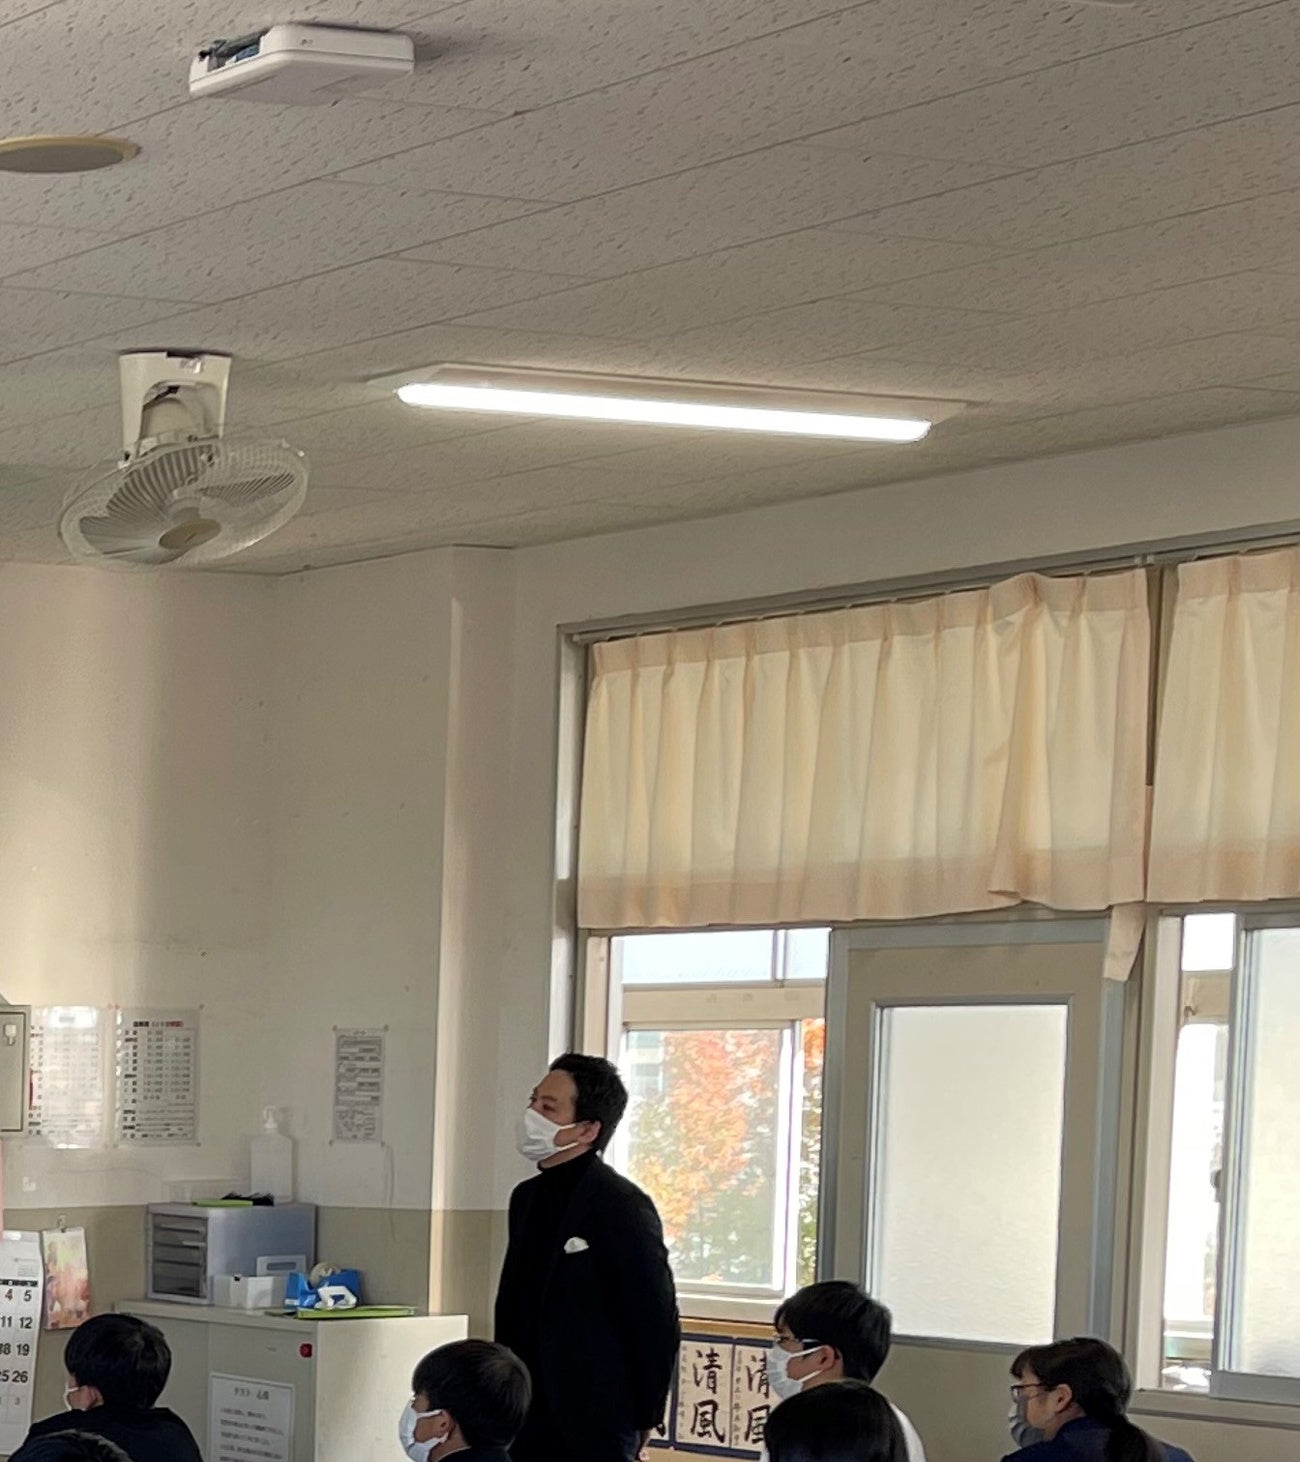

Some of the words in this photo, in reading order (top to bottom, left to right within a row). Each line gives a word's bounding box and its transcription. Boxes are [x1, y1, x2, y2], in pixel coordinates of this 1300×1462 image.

[4, 1288, 13, 1301] 4
[23, 1290, 32, 1302] 5
[0, 1315, 13, 1328] 11
[19, 1316, 33, 1329] 12
[16, 1343, 30, 1356] 19
[11, 1370, 29, 1383] 26
[690, 1347, 726, 1444] 清風
